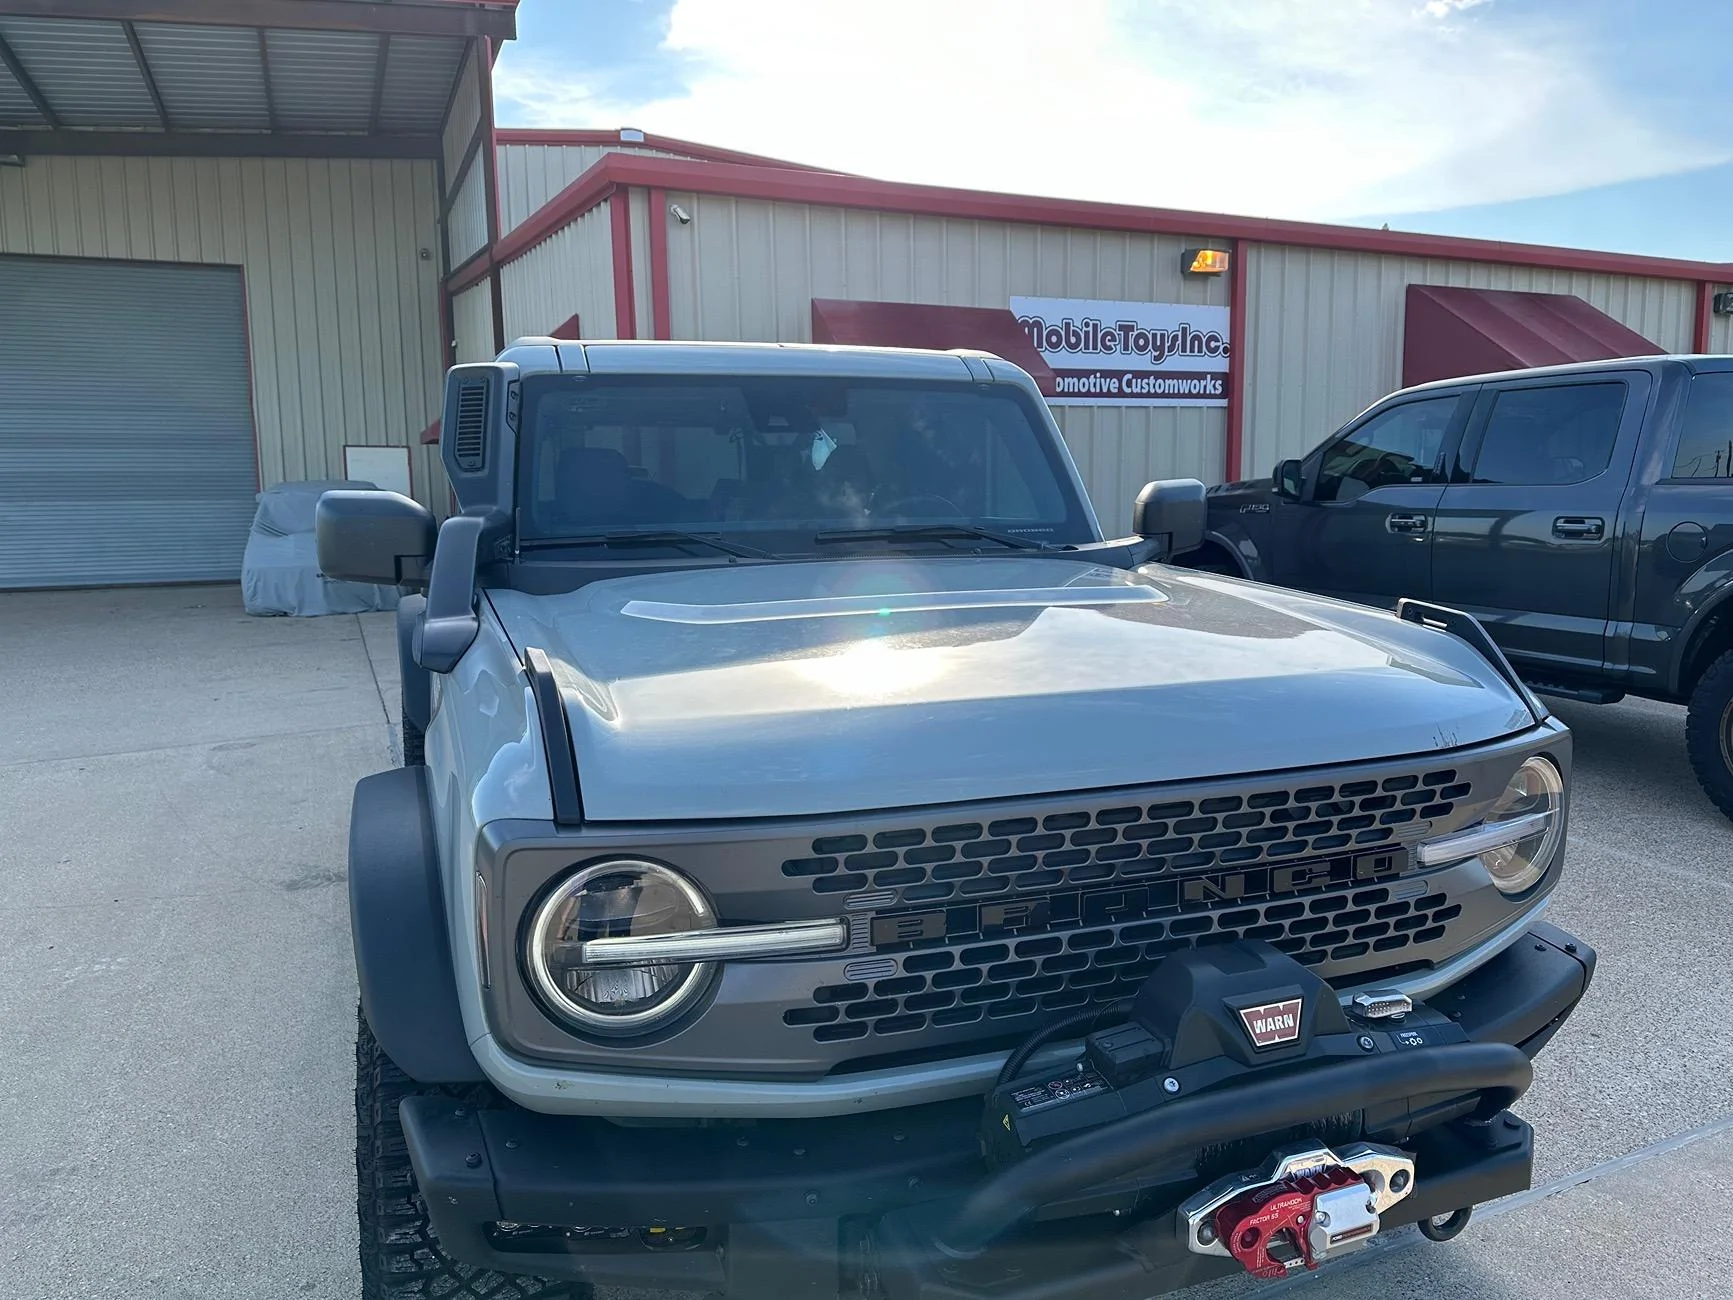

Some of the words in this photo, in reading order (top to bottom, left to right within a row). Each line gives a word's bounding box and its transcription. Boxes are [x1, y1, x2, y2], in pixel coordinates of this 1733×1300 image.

[1055, 372, 1119, 394] omotive
[1121, 373, 1223, 394] Customworks
[869, 847, 1409, 946] BRONCO
[1252, 1013, 1295, 1034] WARN
[1249, 1214, 1270, 1226] FACTOR
